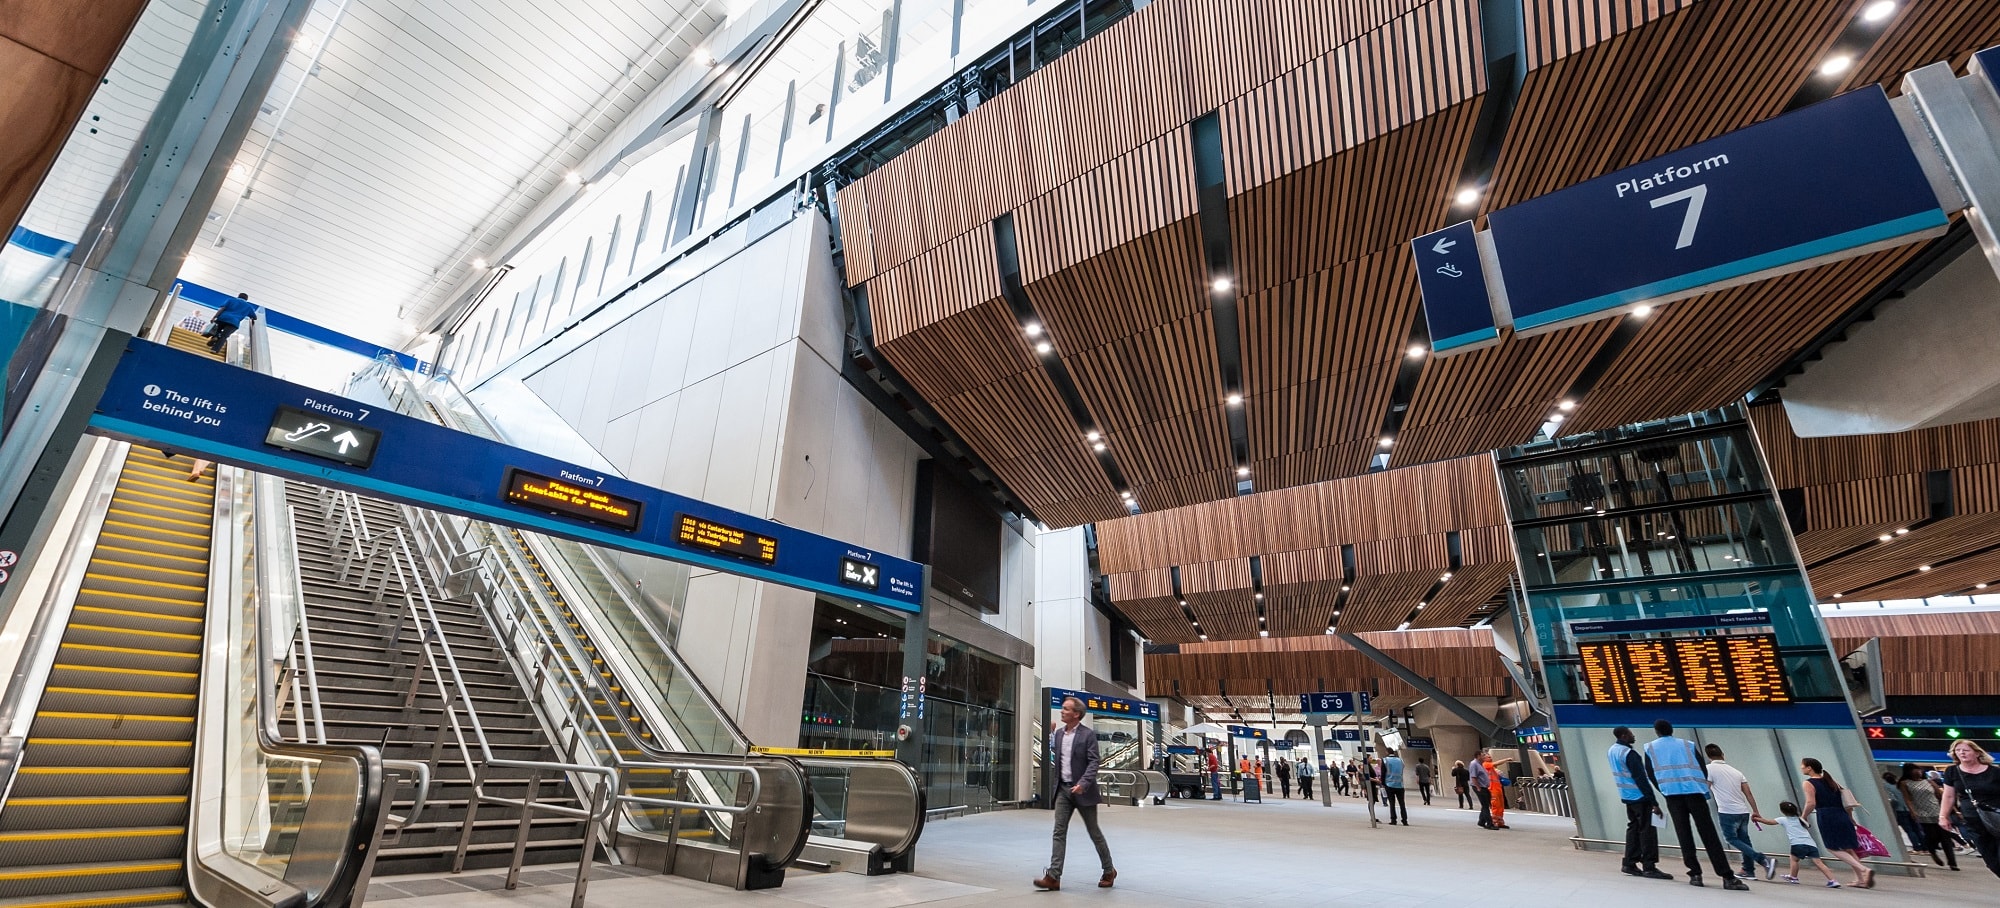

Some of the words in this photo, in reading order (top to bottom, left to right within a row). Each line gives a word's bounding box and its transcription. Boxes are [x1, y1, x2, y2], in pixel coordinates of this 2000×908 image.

[1615, 153, 1729, 198] Platform
[1649, 183, 1708, 250] 7
[165, 389, 190, 404] The
[192, 397, 214, 411] lift
[216, 403, 228, 414] is
[303, 398, 354, 419] Platform
[358, 408, 370, 421] 7
[142, 400, 192, 420] behind
[195, 412, 221, 427] you
[560, 470, 594, 485] Platform
[595, 476, 605, 487] 7
[523, 483, 569, 501] timetable
[571, 496, 587, 505] for
[590, 502, 628, 516] services
[549, 482, 581, 496] Please
[583, 492, 609, 503] check
[847, 549, 866, 560] Platform
[866, 552, 872, 561] 7
[845, 569, 862, 581] Entry
[891, 585, 906, 594] behind
[1321, 698, 1329, 709] 8
[1335, 698, 1343, 709] 9
